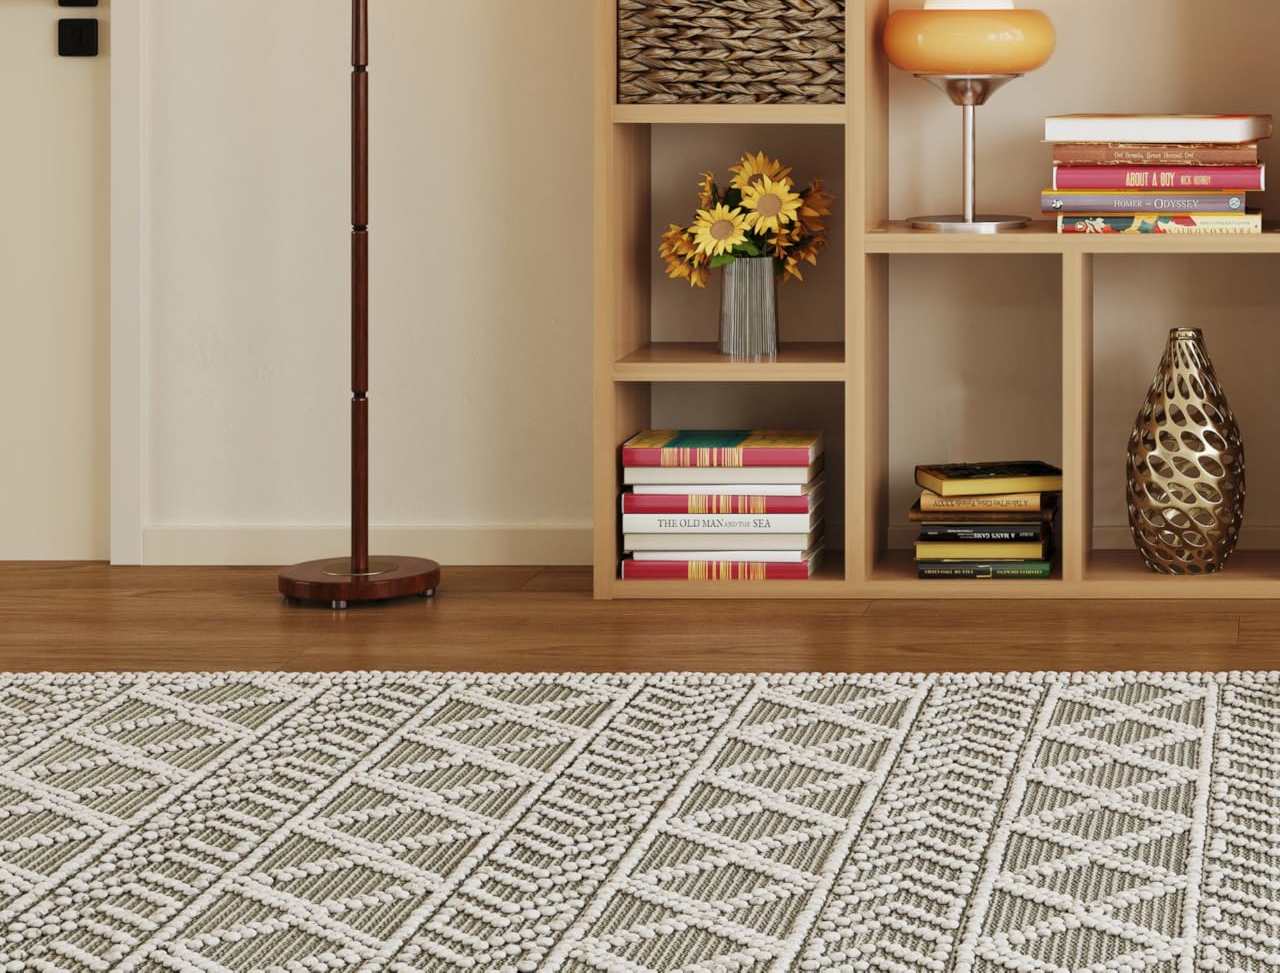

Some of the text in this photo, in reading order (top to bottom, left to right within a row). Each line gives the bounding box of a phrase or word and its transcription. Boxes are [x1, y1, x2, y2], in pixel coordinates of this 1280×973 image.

[1125, 172, 1149, 187] ABOUT
[1151, 172, 1157, 187] A
[1160, 172, 1175, 187] BOY
[1113, 198, 1199, 209] HOMER ODYSSEY
[657, 518, 678, 528] THE
[679, 518, 700, 528] OLD
[702, 518, 724, 528] MAN
[752, 518, 771, 528] SEA
